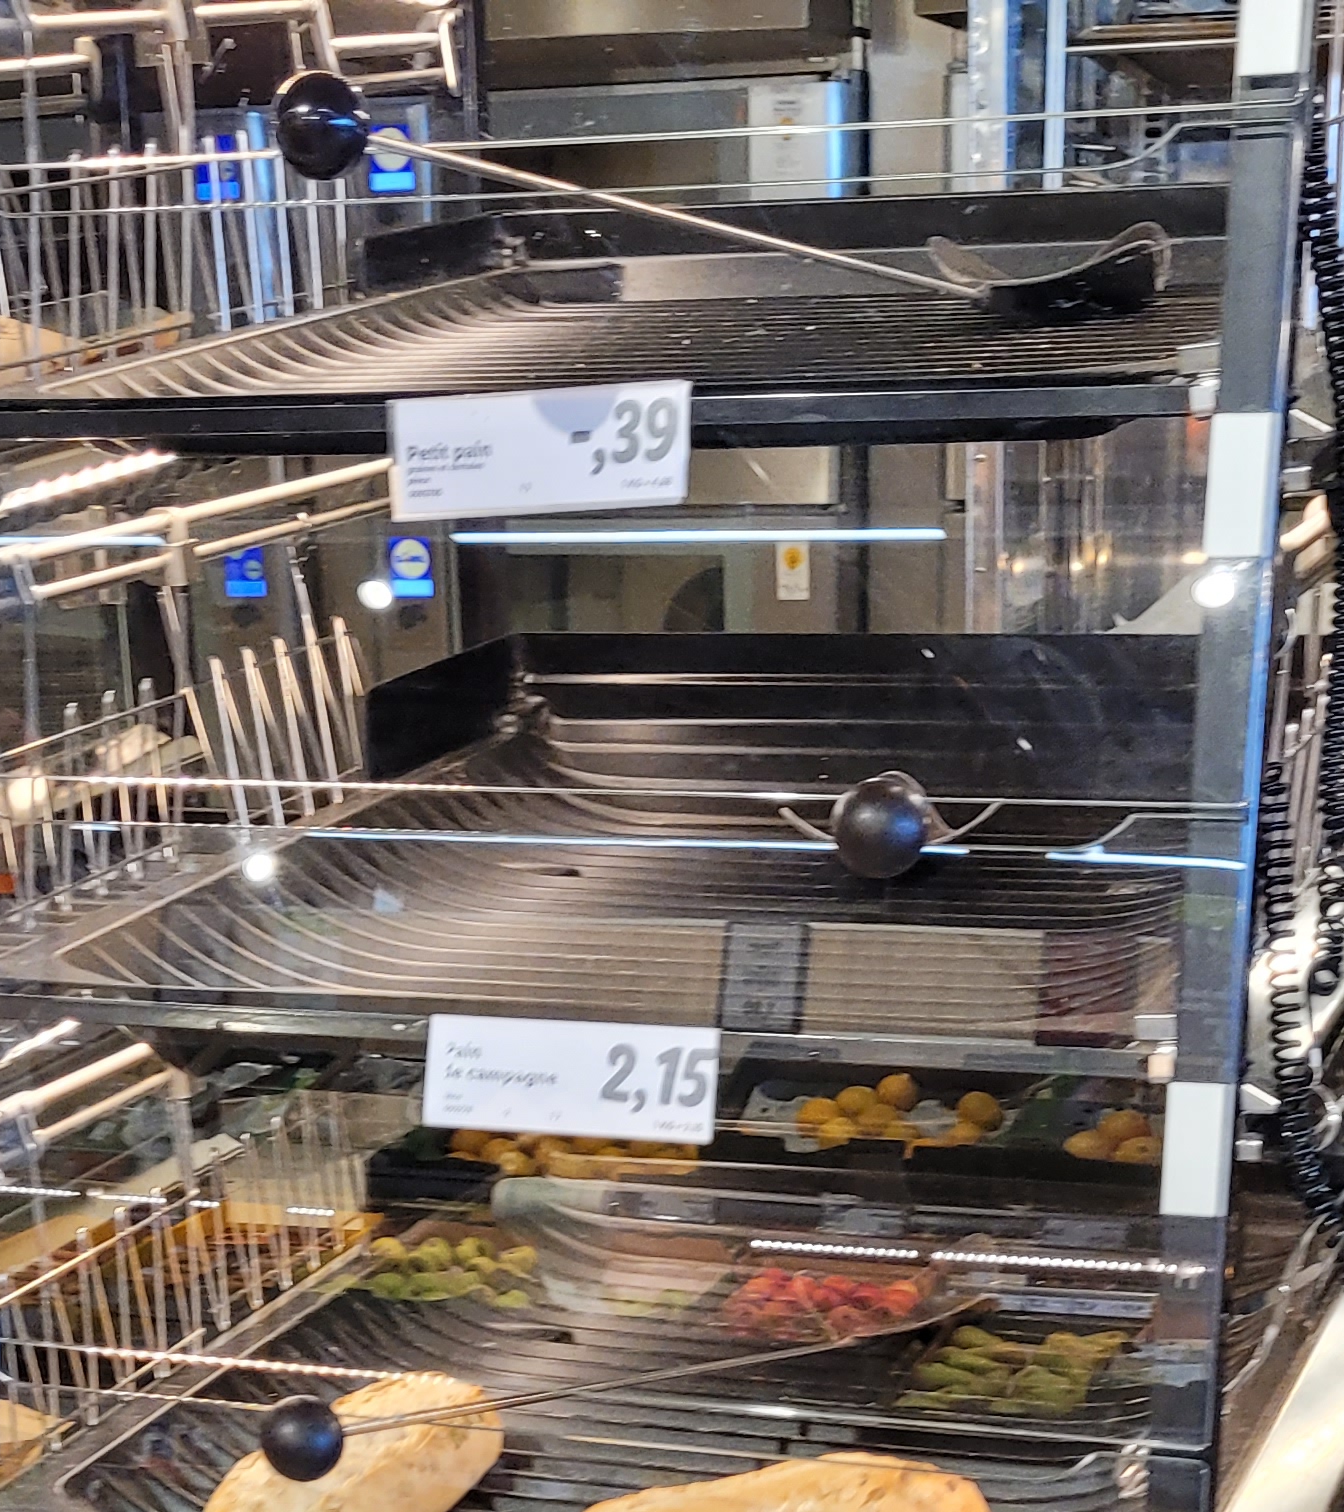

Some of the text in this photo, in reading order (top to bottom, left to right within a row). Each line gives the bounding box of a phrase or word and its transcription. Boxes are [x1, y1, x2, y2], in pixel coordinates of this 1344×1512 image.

[406, 439, 494, 462] Petit pain
[568, 397, 678, 476] -,39
[446, 1040, 483, 1059] Pain
[600, 1042, 720, 1114] 2,15
